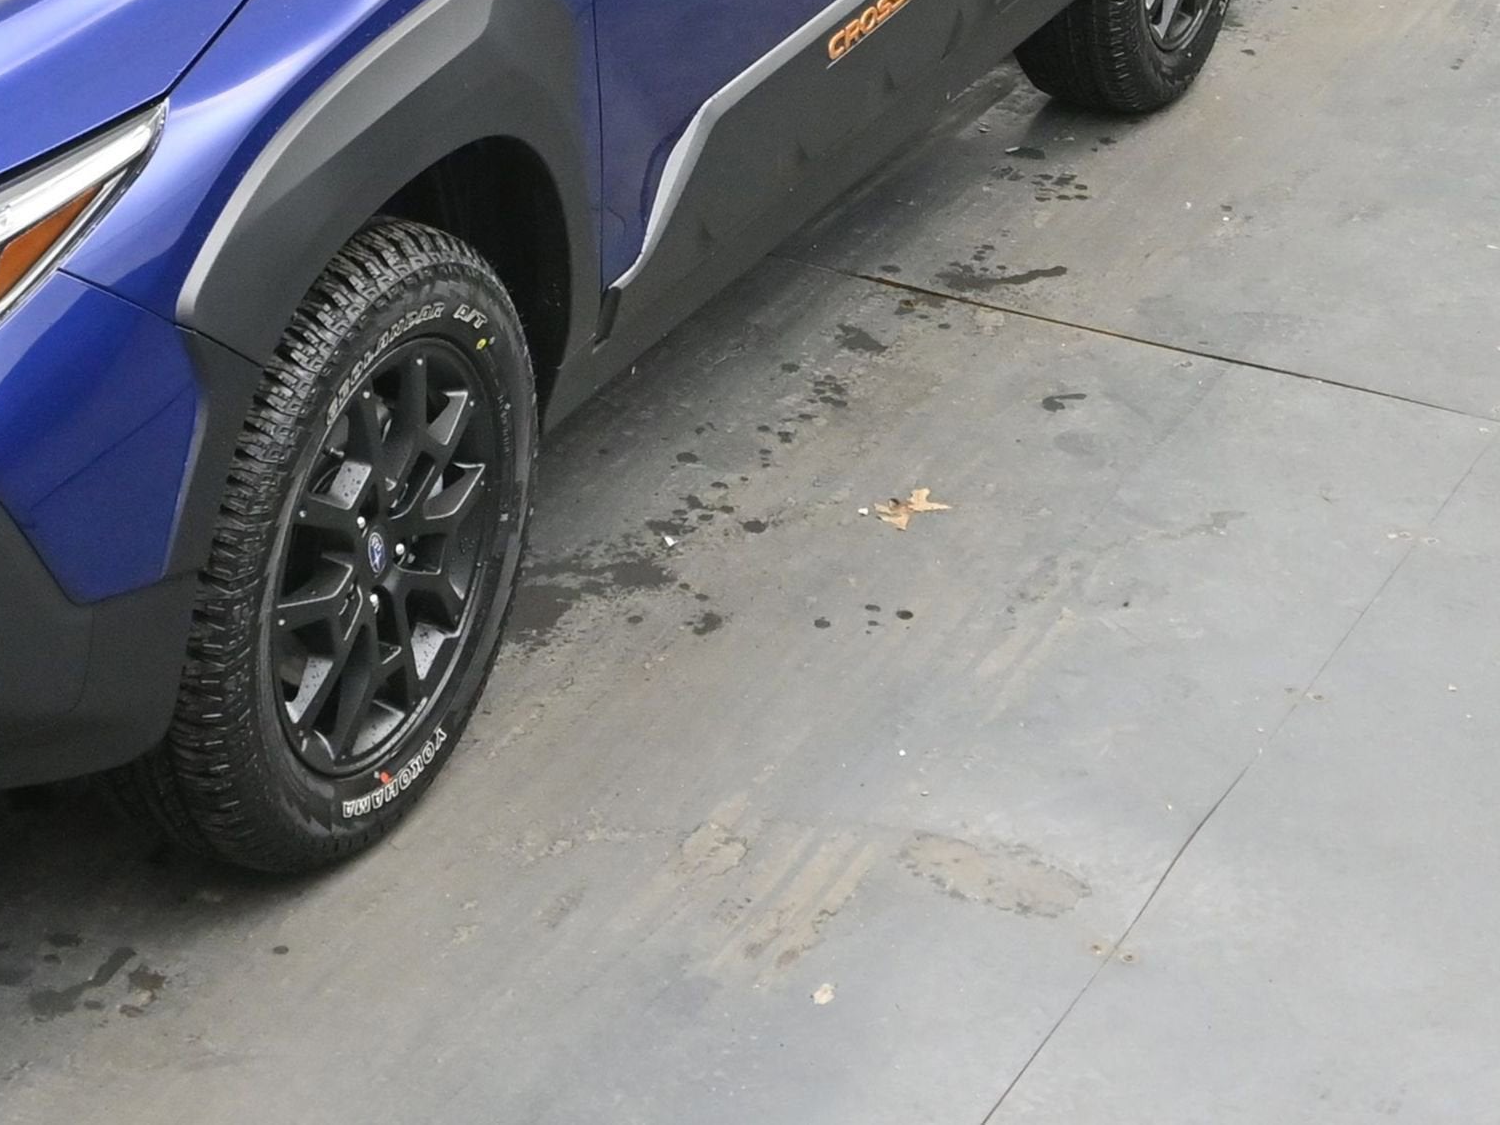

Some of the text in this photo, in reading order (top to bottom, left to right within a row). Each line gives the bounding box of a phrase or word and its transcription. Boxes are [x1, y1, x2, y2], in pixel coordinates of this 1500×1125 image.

[326, 302, 445, 426] GEOLANDAR
[452, 303, 488, 330] A/T
[342, 727, 448, 819] YOKOHAMA
